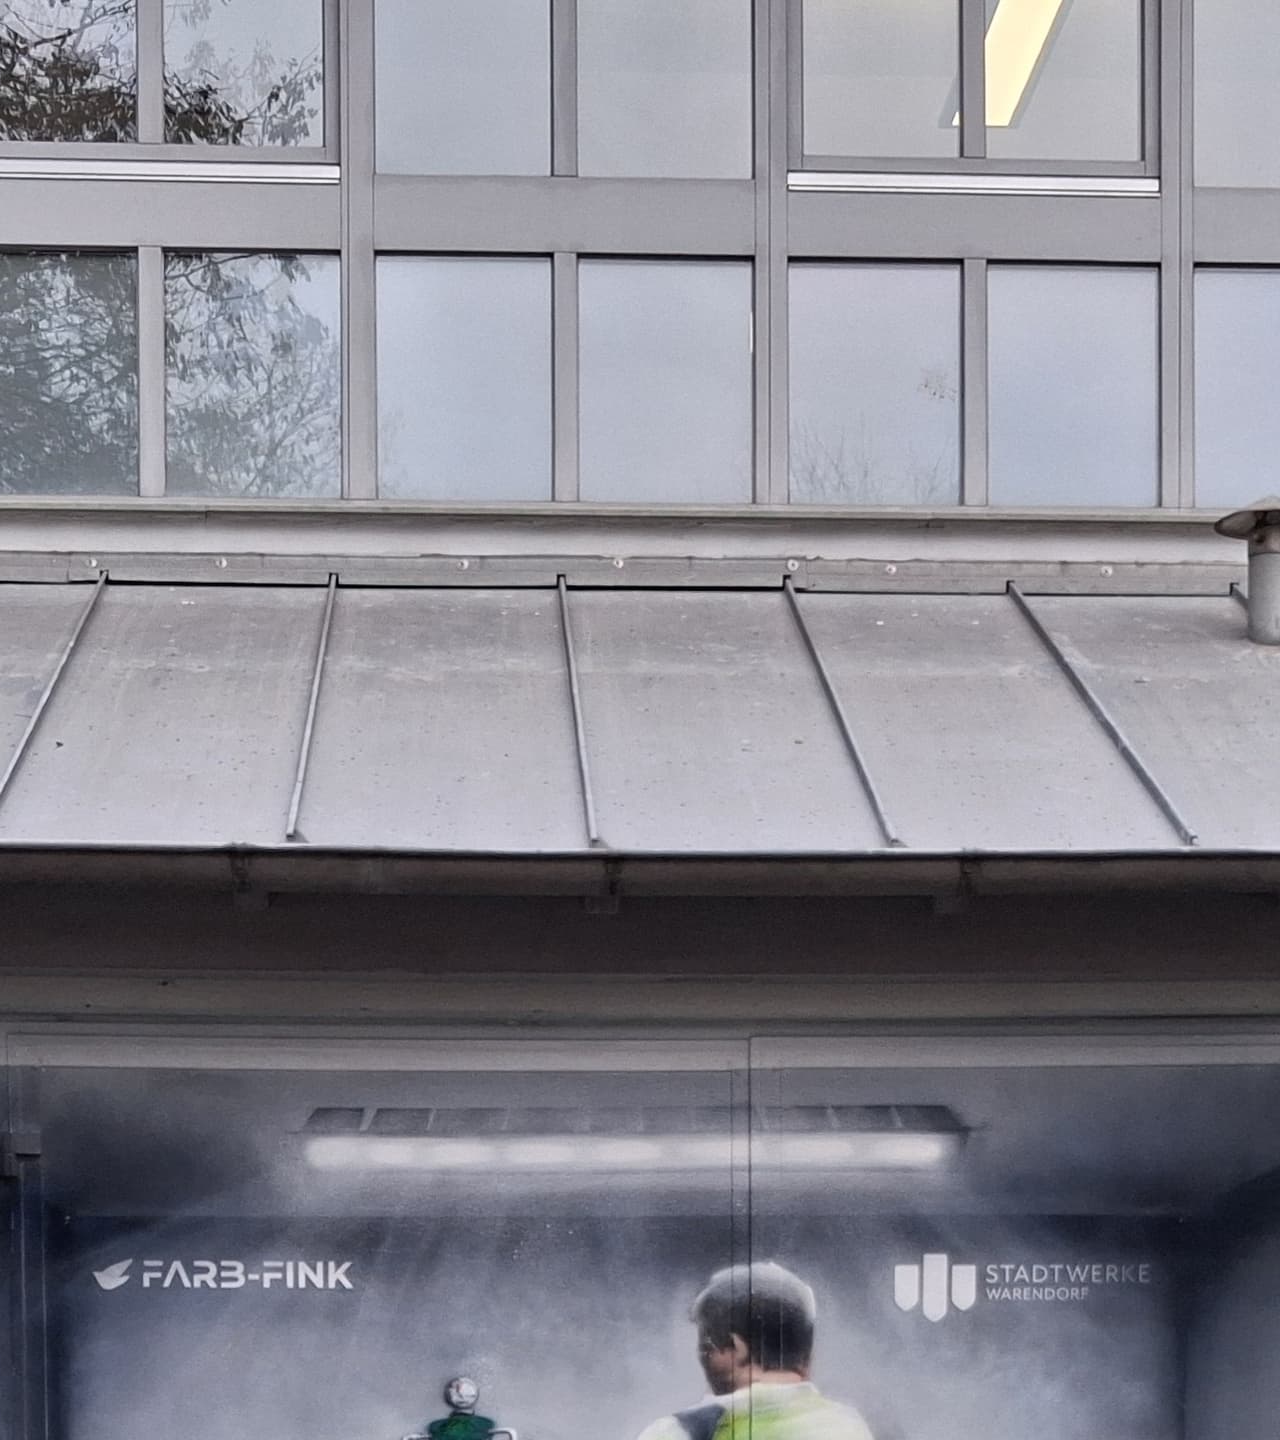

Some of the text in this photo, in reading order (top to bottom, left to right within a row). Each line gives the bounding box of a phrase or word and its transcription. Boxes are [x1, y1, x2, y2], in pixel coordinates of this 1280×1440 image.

[142, 1259, 354, 1290] FARB-FINK
[985, 1264, 1151, 1284] STADTWERKE
[985, 1286, 1089, 1301] WARENDORF
